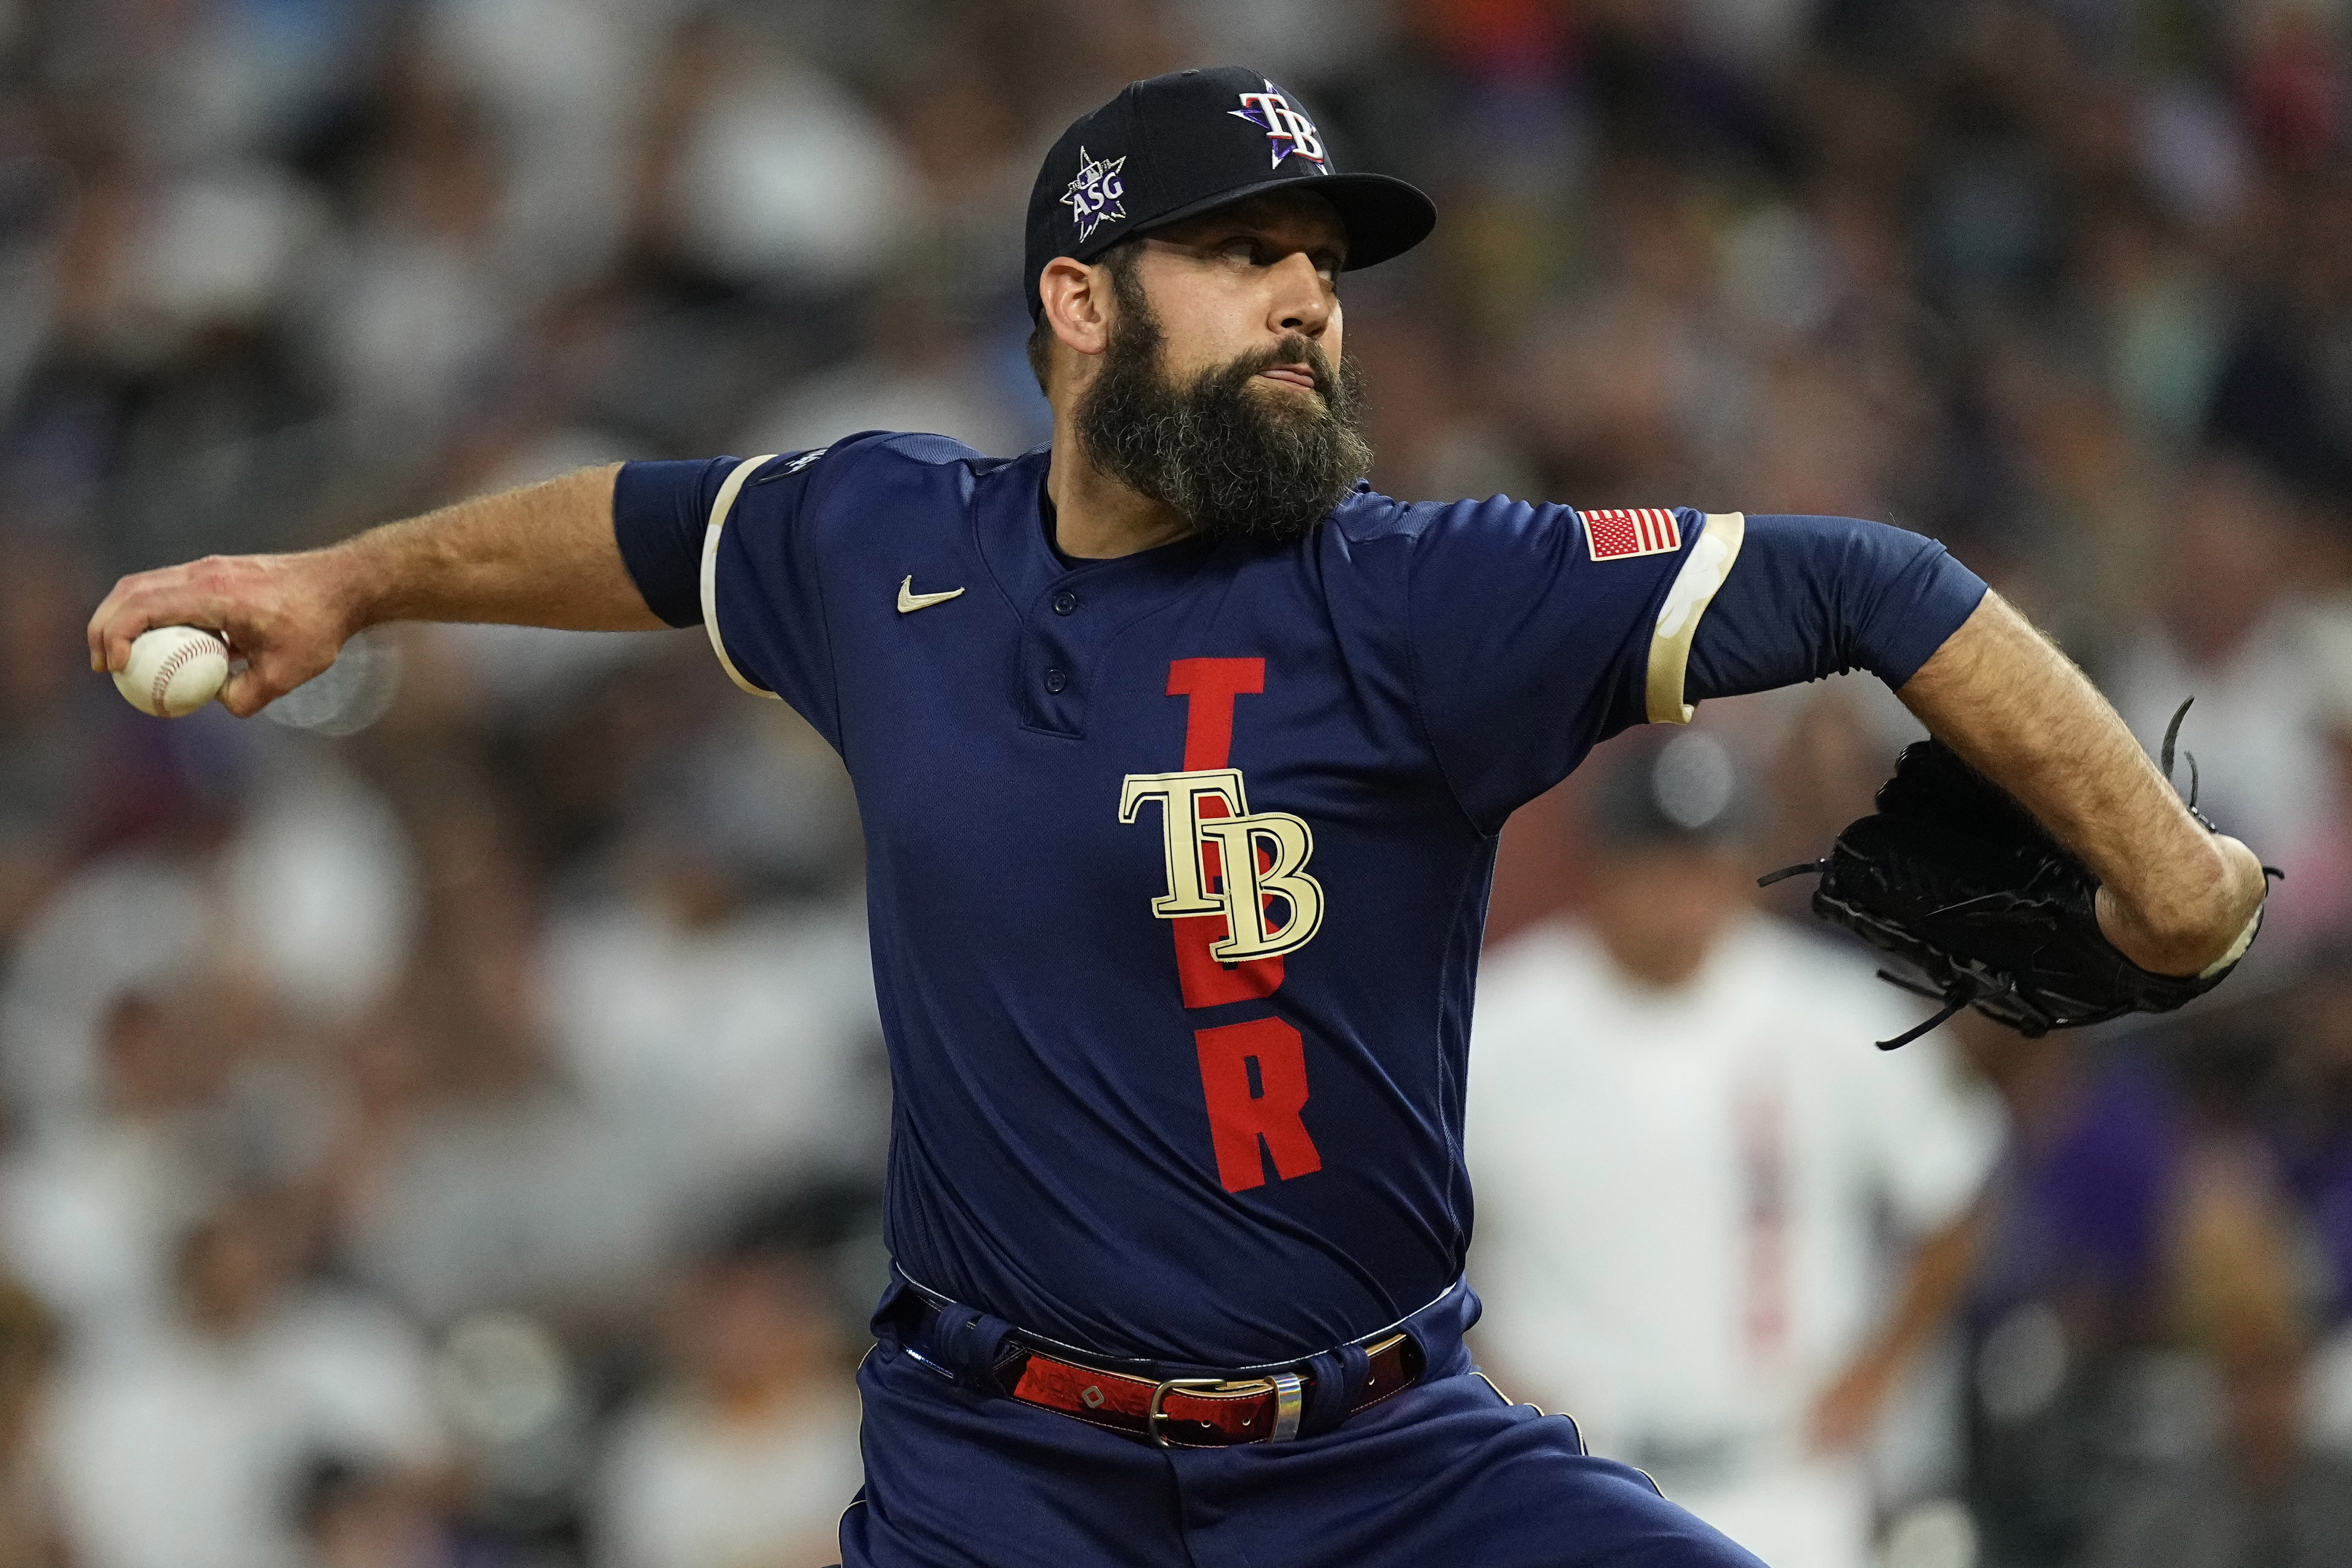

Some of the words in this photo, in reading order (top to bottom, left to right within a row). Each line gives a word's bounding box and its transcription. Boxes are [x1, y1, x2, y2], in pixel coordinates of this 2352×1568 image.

[1238, 93, 1324, 164] TB
[1073, 171, 1124, 223] ASG
[1118, 768, 1325, 963] TB
